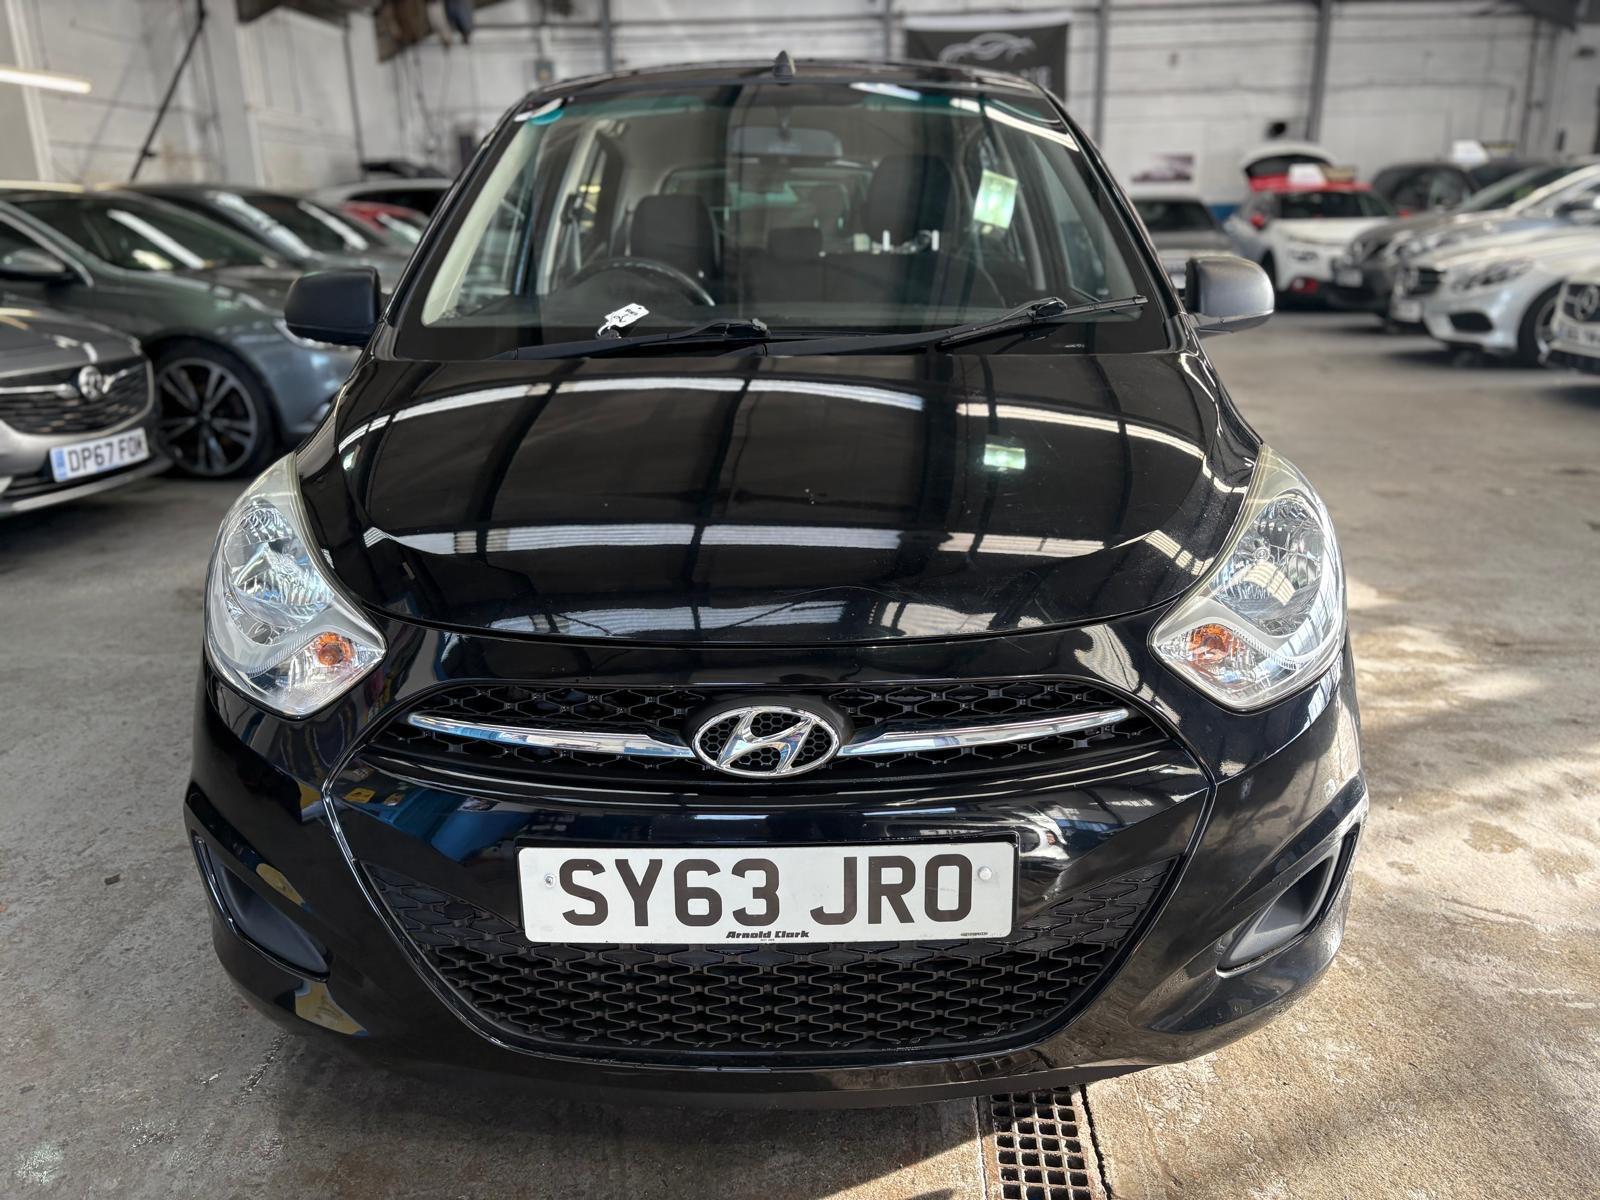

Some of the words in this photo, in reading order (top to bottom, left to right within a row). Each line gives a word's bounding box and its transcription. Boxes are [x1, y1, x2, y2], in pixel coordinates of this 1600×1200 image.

[68, 442, 114, 472] DP67
[559, 857, 780, 927] SY63
[810, 854, 972, 925] JRO
[726, 930, 772, 939] Arnold
[774, 930, 810, 938] Clark
